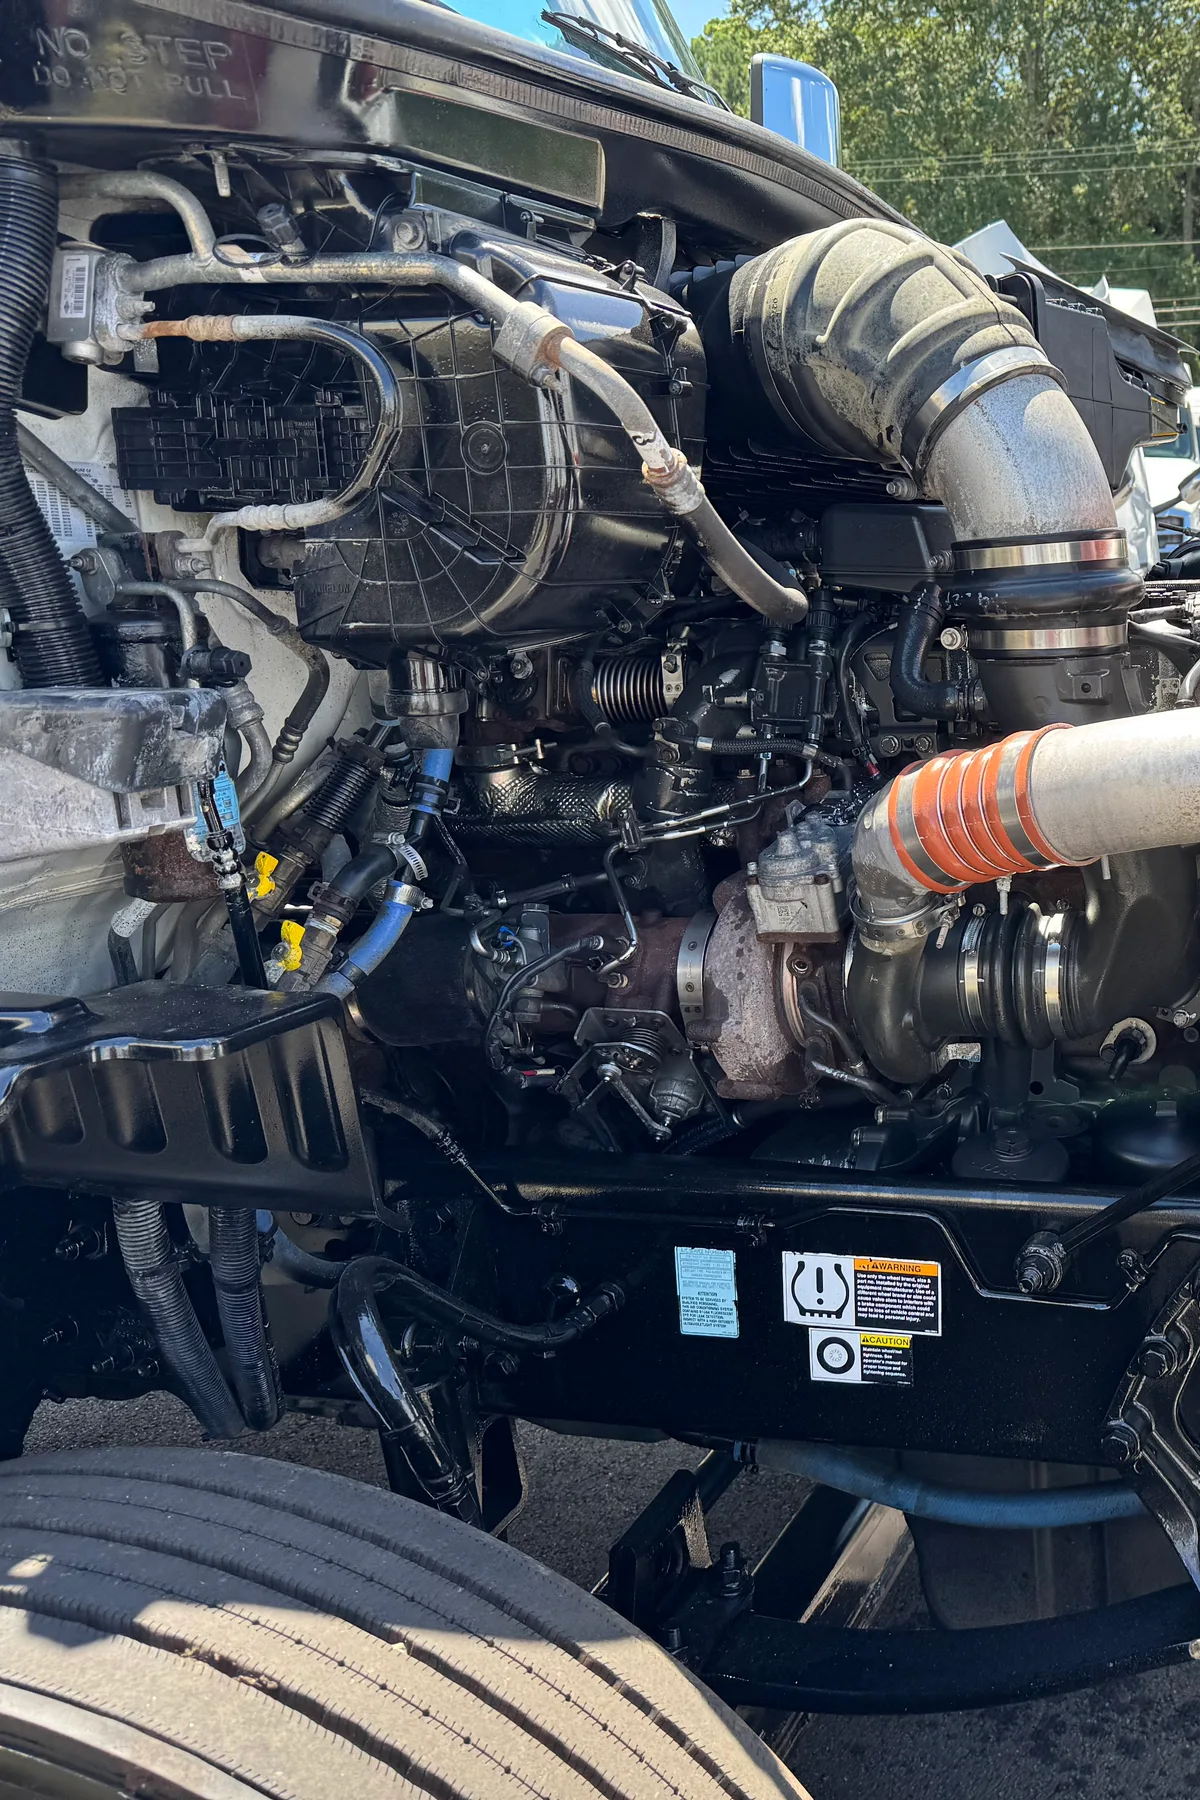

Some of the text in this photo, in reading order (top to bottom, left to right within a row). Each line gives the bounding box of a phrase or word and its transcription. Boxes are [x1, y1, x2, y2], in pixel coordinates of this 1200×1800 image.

[36, 27, 233, 71] NO STEP
[33, 63, 247, 101] DO NOT PULL
[879, 1262, 921, 1272] WARNING
[869, 1336, 909, 1346] CAUTION
